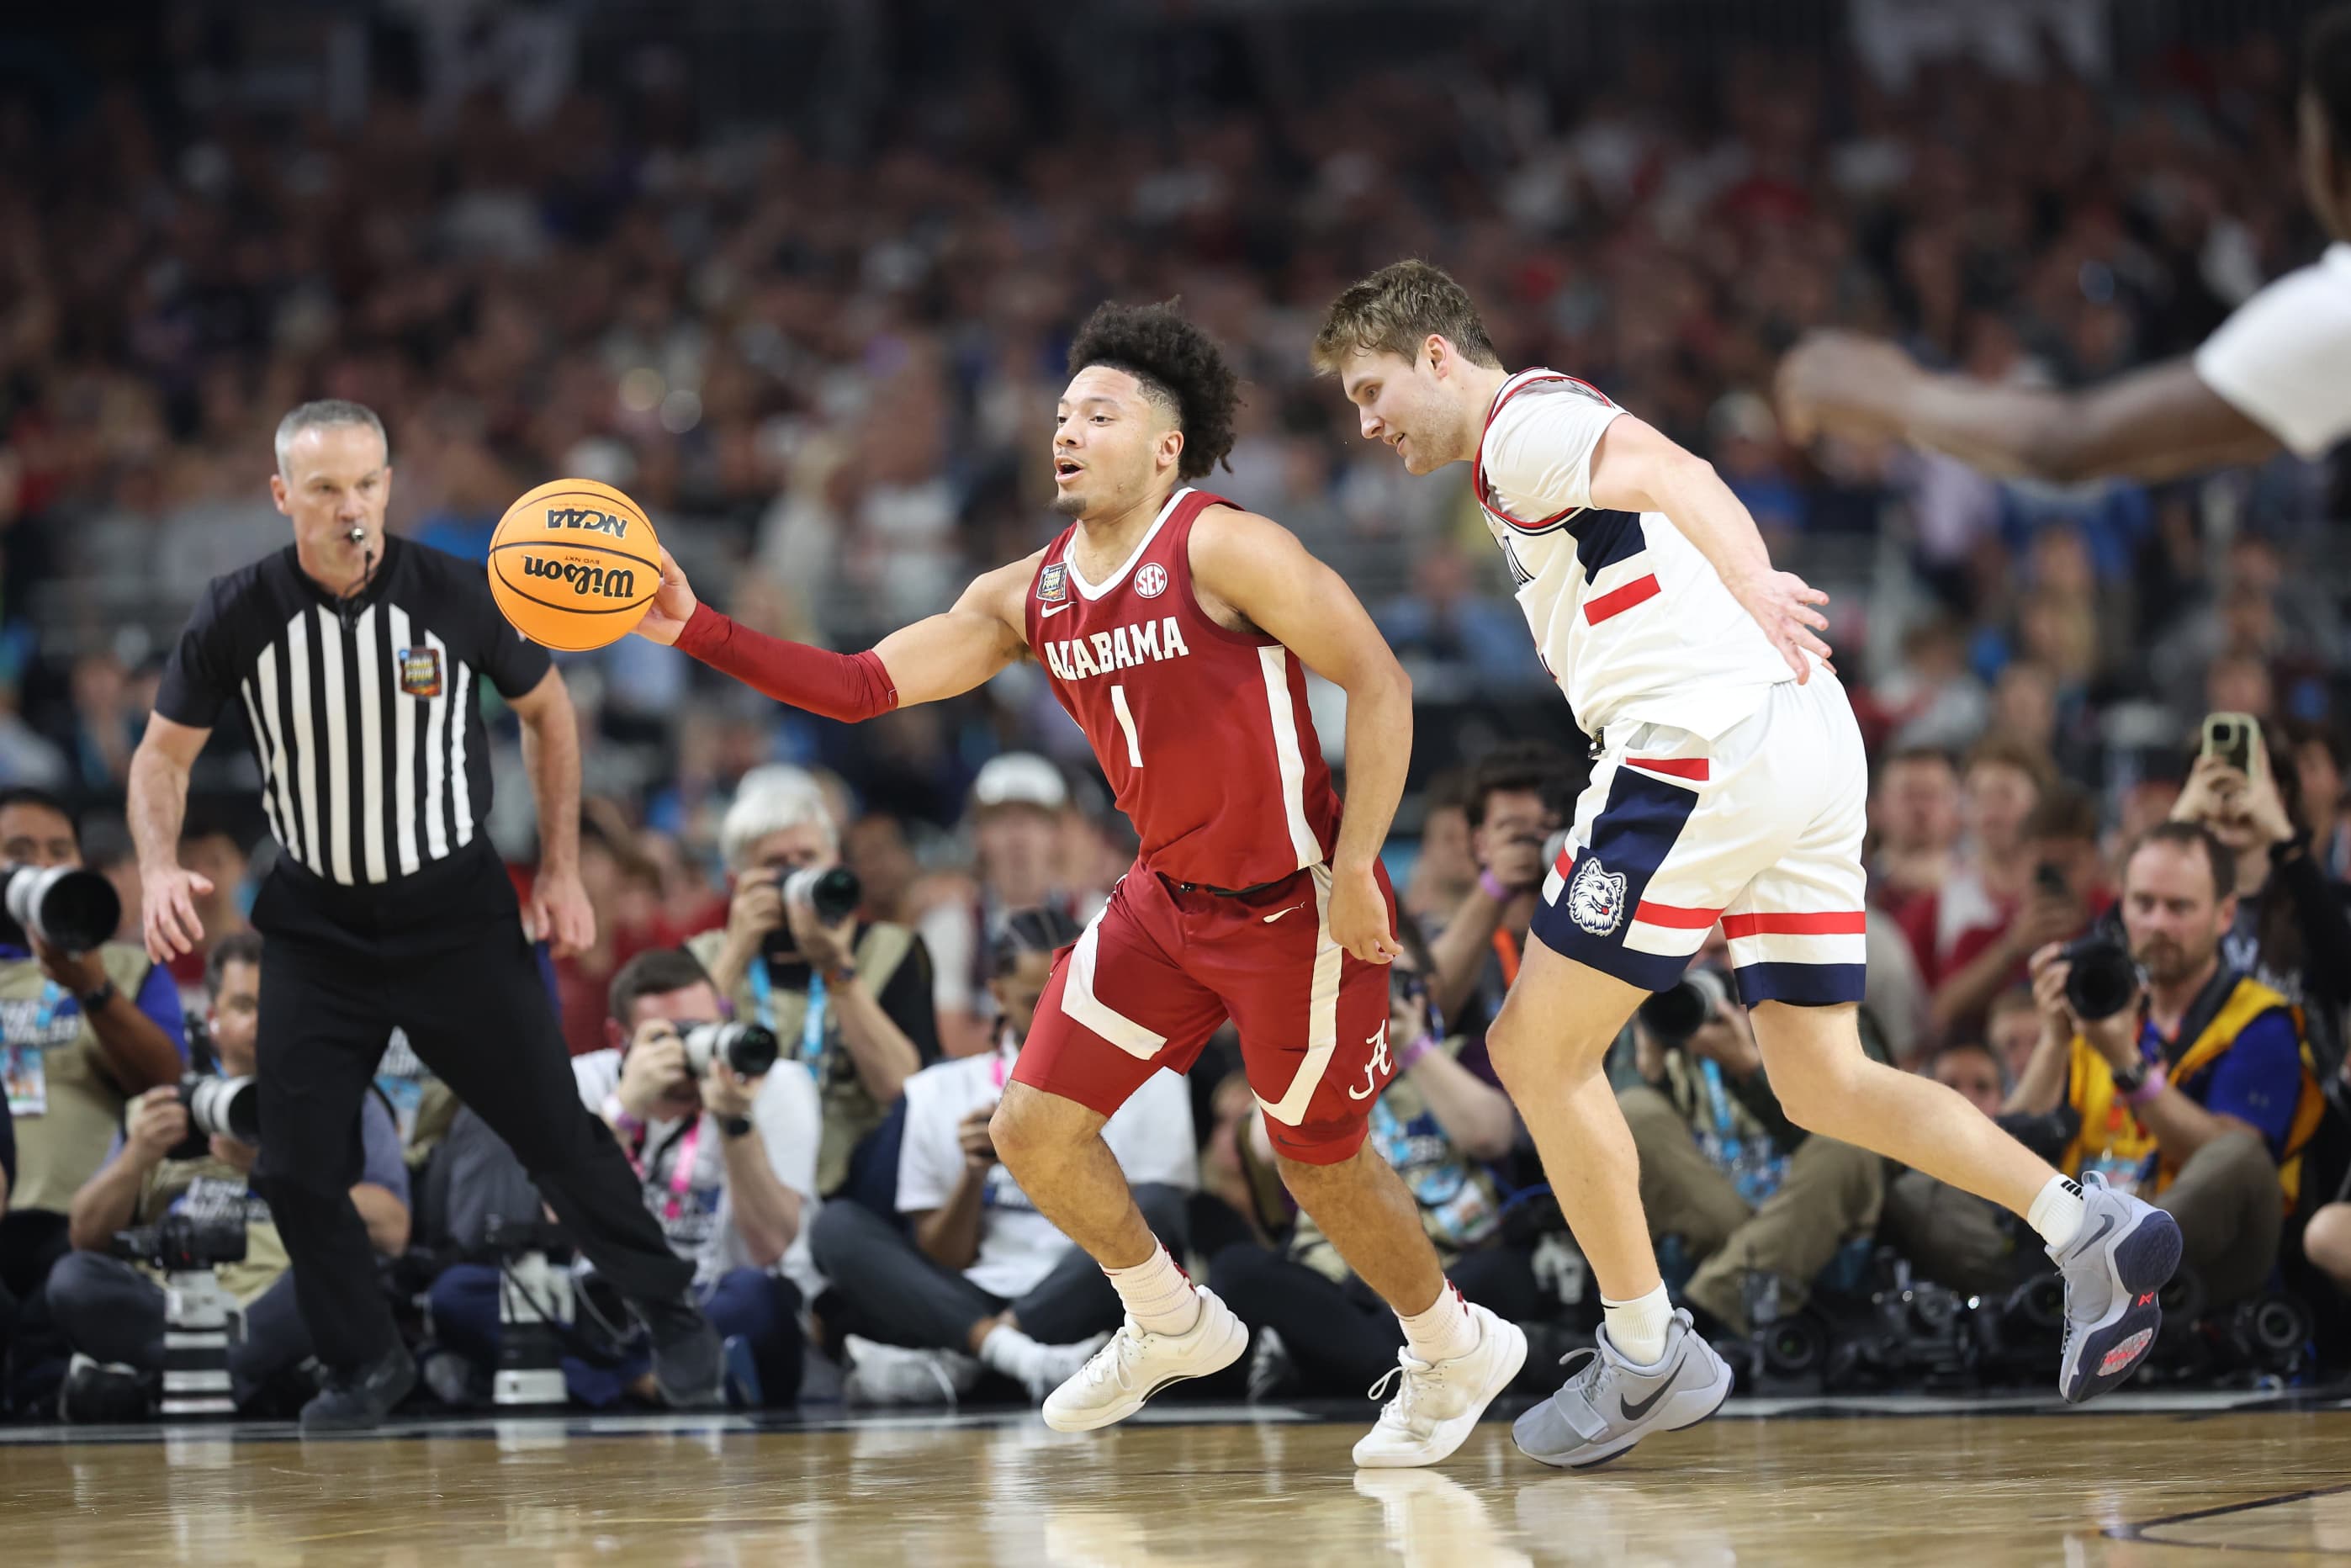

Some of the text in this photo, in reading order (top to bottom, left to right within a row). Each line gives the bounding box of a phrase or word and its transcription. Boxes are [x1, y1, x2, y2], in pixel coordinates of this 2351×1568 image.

[546, 507, 628, 539] NCAA
[523, 555, 634, 599] Wilson
[1136, 564, 1166, 596] SEC
[1044, 616, 1190, 681] ALABAMA
[1110, 684, 1144, 768] 1
